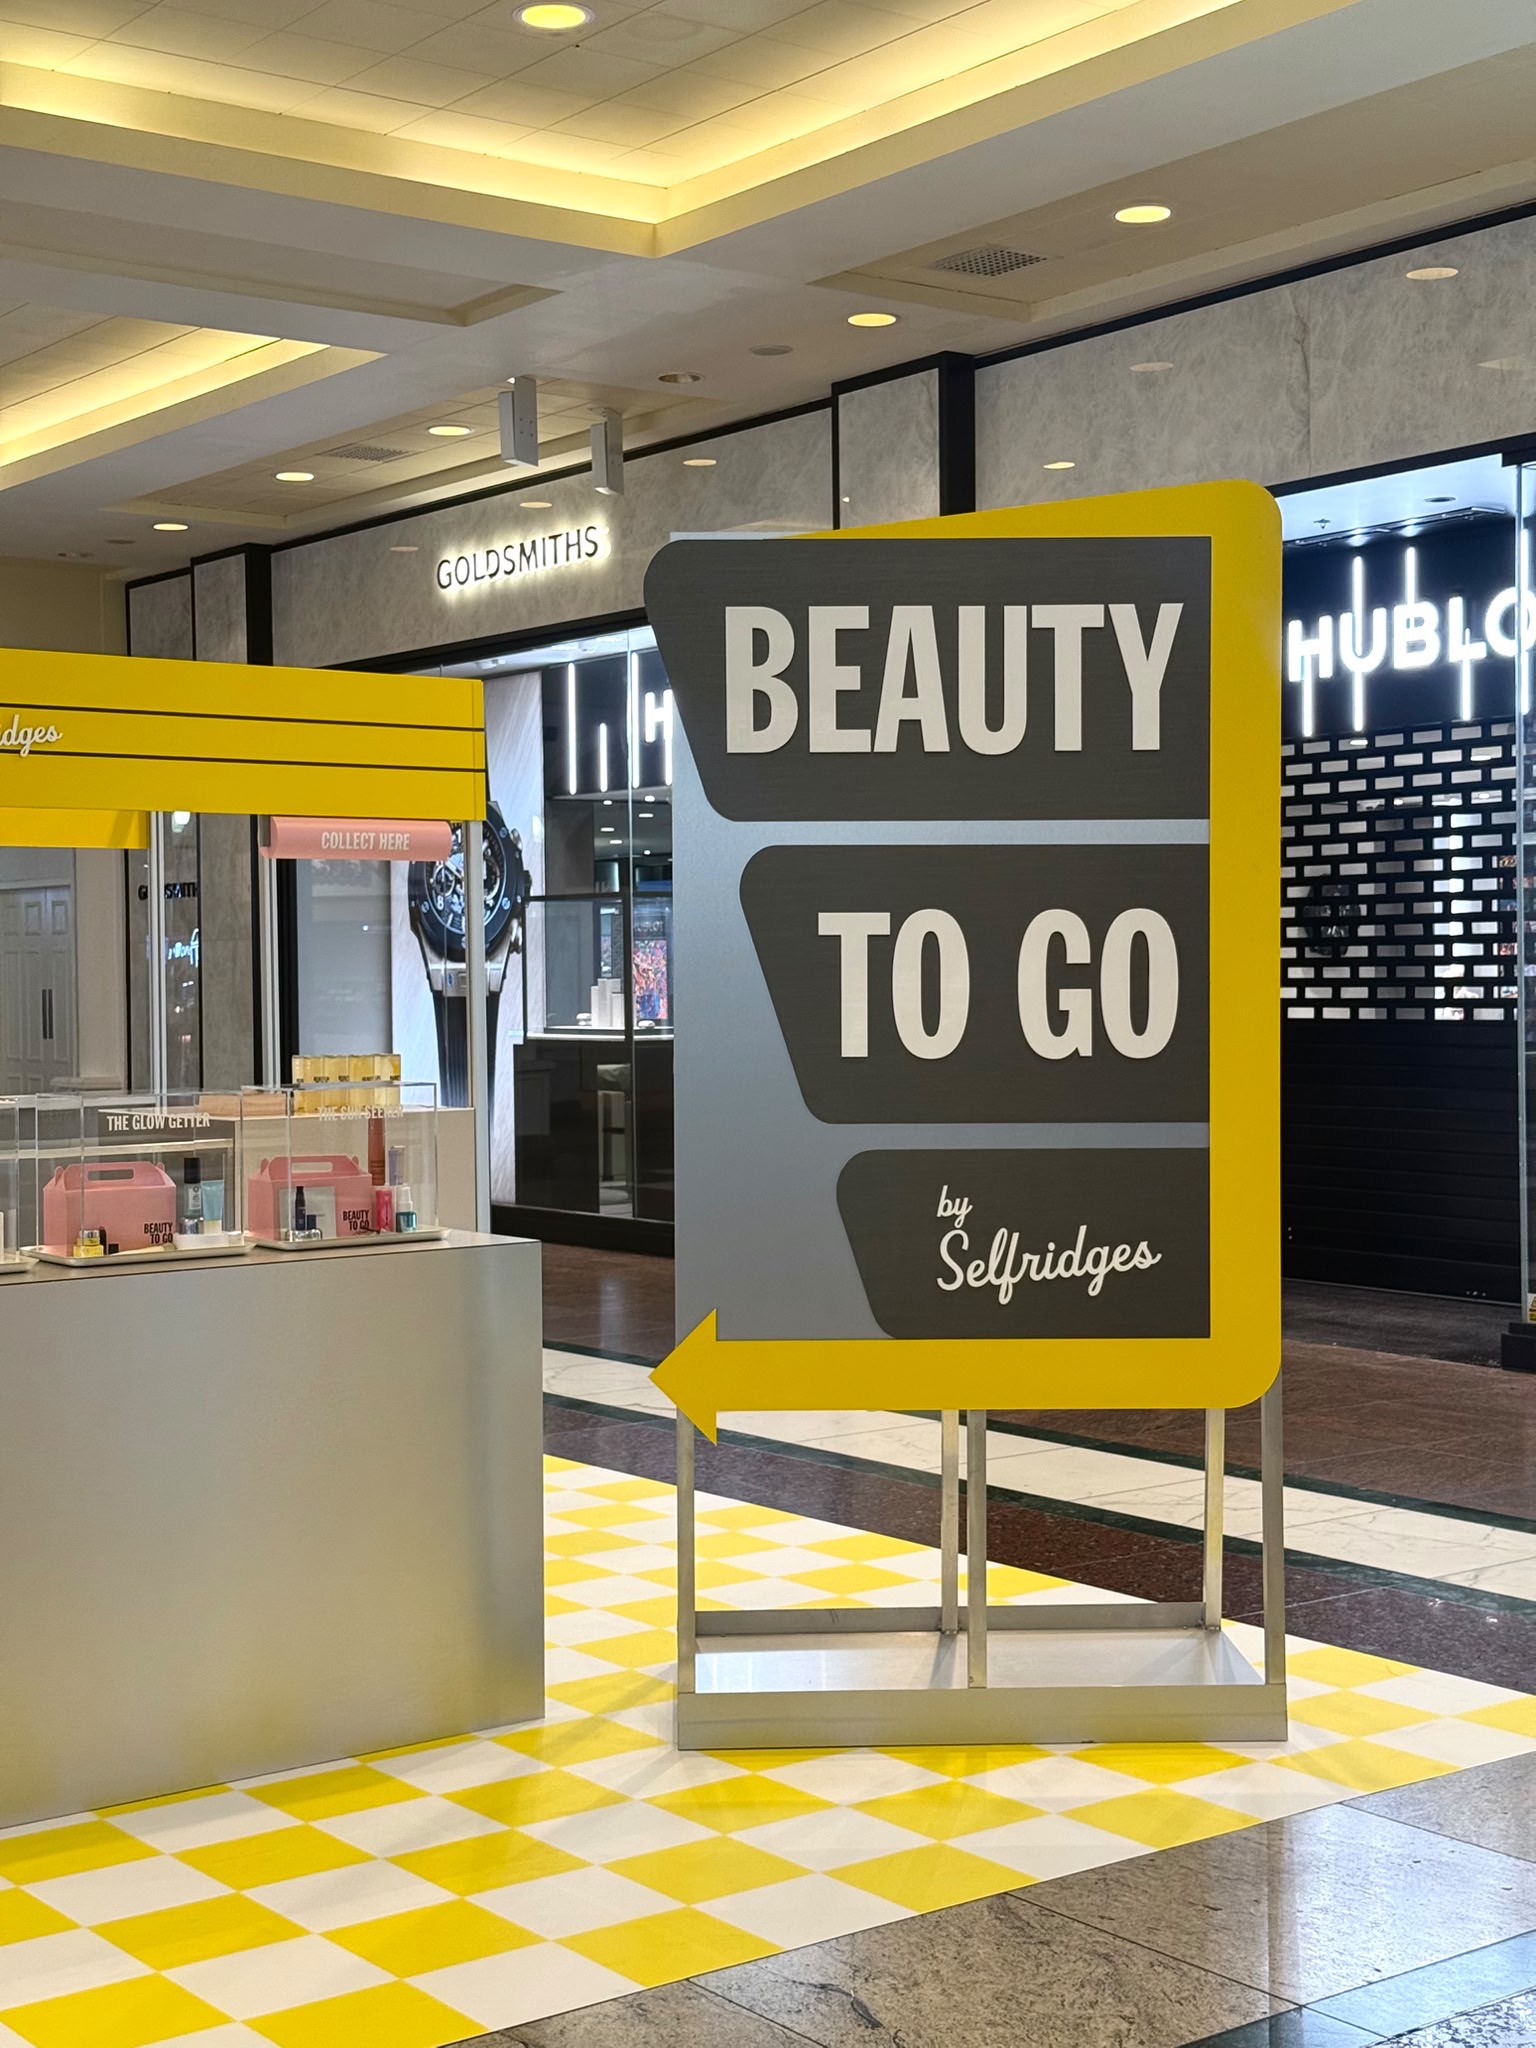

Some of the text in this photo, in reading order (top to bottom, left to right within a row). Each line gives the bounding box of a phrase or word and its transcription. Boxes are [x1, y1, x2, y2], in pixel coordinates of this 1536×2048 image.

[436, 525, 599, 590] GOLDSMITHS
[726, 603, 1183, 754] BEAUTY
[0, 714, 63, 757] dges
[321, 831, 410, 851] COLLECT HERE
[819, 908, 1178, 1059] TO GO
[106, 1112, 211, 1131] THE GLOW GETTER
[343, 1210, 369, 1221] BEAUTY
[937, 1185, 973, 1229] by
[144, 1222, 173, 1234] BEAUTY
[150, 1232, 173, 1244] TO GO
[349, 1220, 370, 1231] TO GO
[937, 1224, 1162, 1305] Selfridges
